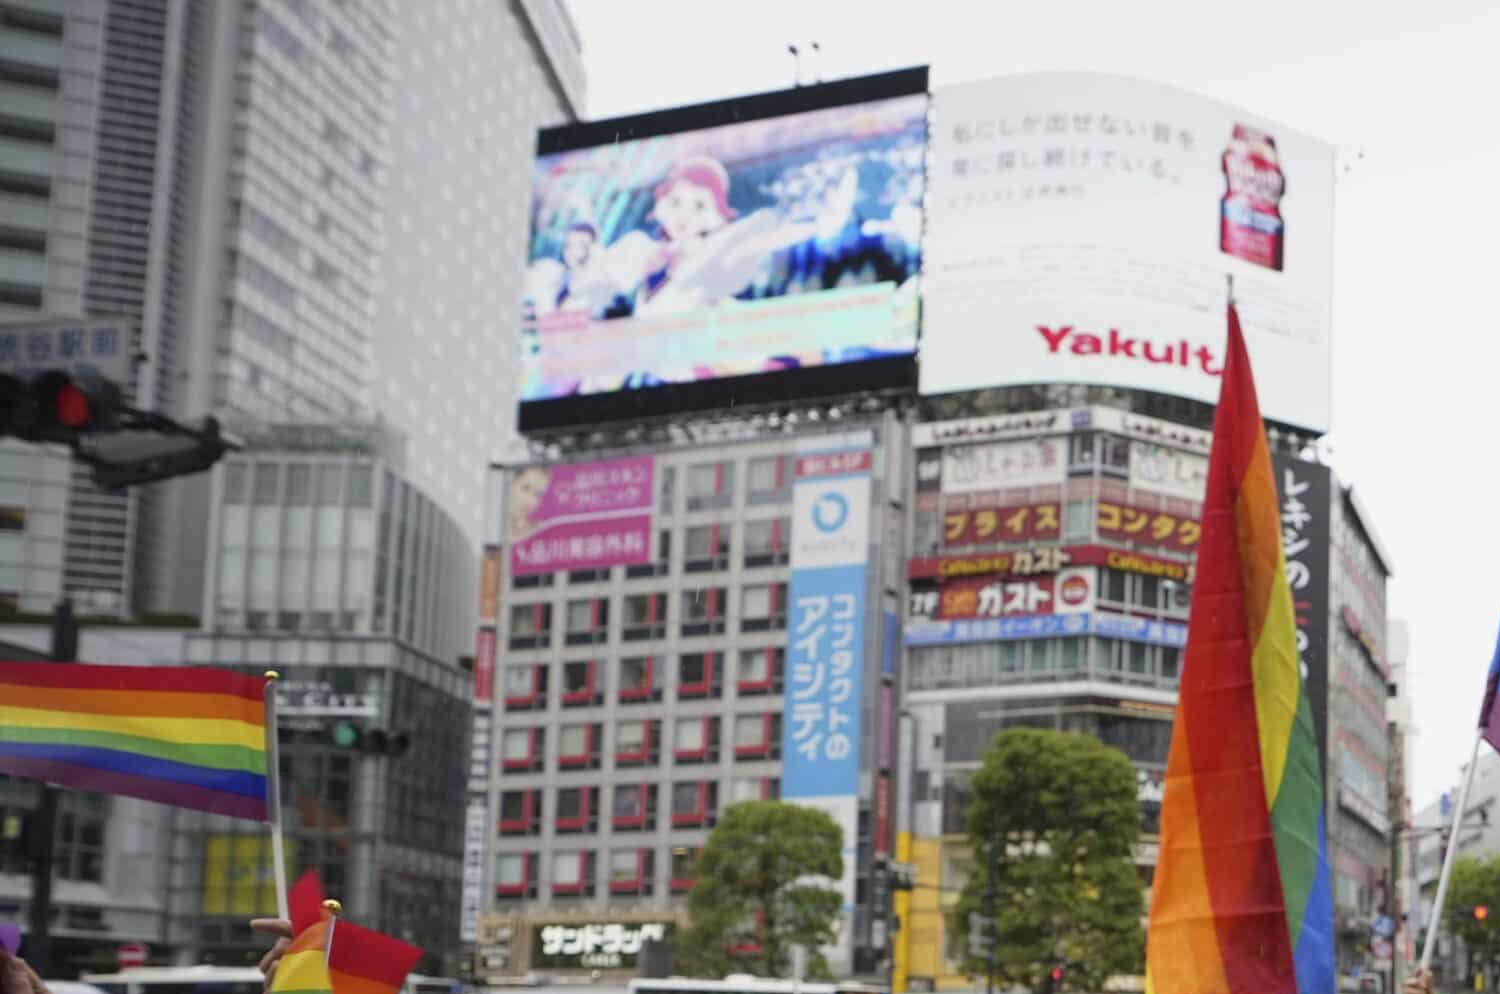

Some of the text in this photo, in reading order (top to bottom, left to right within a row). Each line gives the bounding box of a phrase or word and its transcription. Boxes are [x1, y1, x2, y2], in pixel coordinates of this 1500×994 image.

[1035, 325, 1223, 377] Yakult
[1098, 503, 1201, 546] コンタク
[1011, 547, 1073, 576] ガスト
[977, 580, 1050, 617] ガスト
[793, 594, 830, 763] アイシティ
[826, 594, 857, 761] コンタクトの
